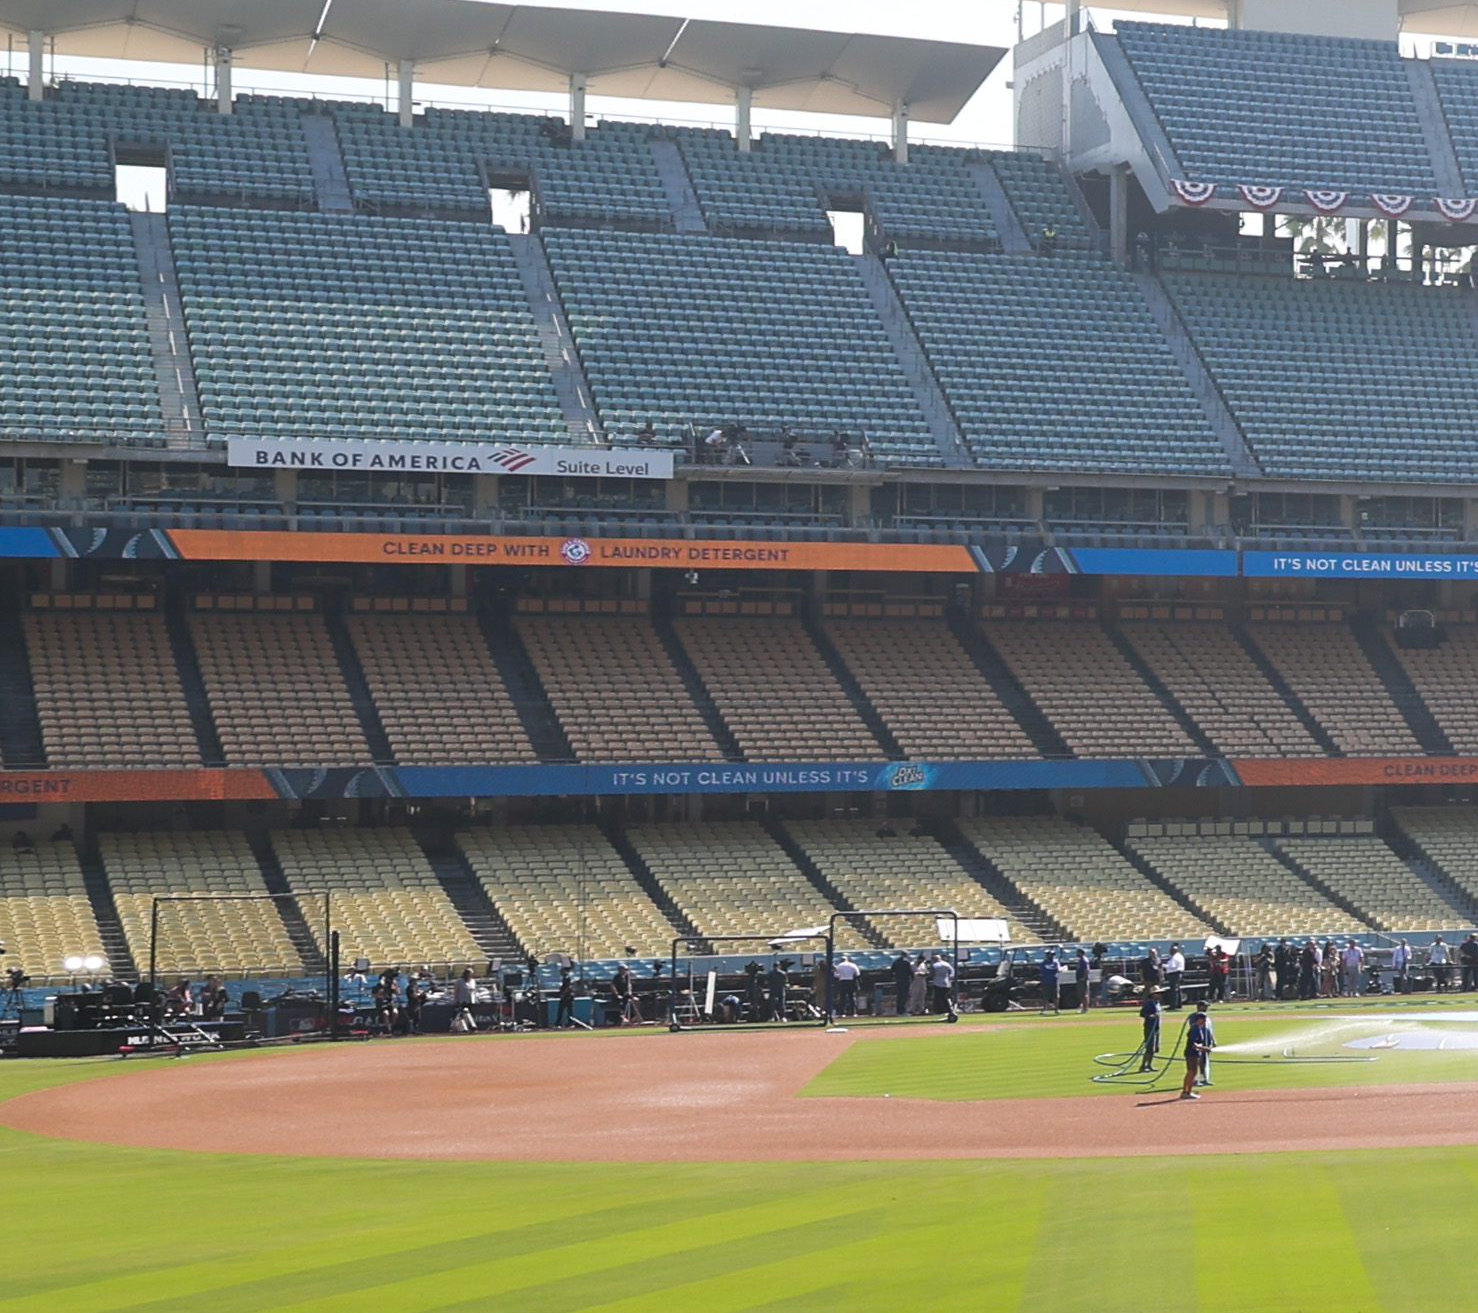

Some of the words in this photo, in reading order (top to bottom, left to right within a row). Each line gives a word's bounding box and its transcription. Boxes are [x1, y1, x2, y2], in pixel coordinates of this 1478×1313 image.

[256, 451, 323, 466] BANK
[332, 453, 362, 467] OF
[370, 454, 481, 470] AMERICA
[557, 459, 600, 475] Suite
[605, 461, 648, 476] Level
[383, 541, 444, 555] CLEAN
[452, 543, 497, 556] DEEP
[504, 544, 549, 556] WITH
[601, 546, 682, 559] LAUNDRY
[688, 548, 789, 561] DETERGENT
[1274, 558, 1301, 570] IT'S
[1306, 559, 1337, 570] NOT
[1342, 559, 1391, 571] CLEAN
[1396, 561, 1451, 572] UNLESS
[613, 773, 646, 785] IT'S
[653, 772, 690, 785] NOT
[698, 772, 756, 785] CLEAN
[764, 771, 830, 784] UNLESS
[837, 770, 868, 784] IT'S
[1384, 765, 1434, 777] CLEAN
[1440, 765, 1477, 776] DEEP
[891, 771, 924, 787] CLEAN
